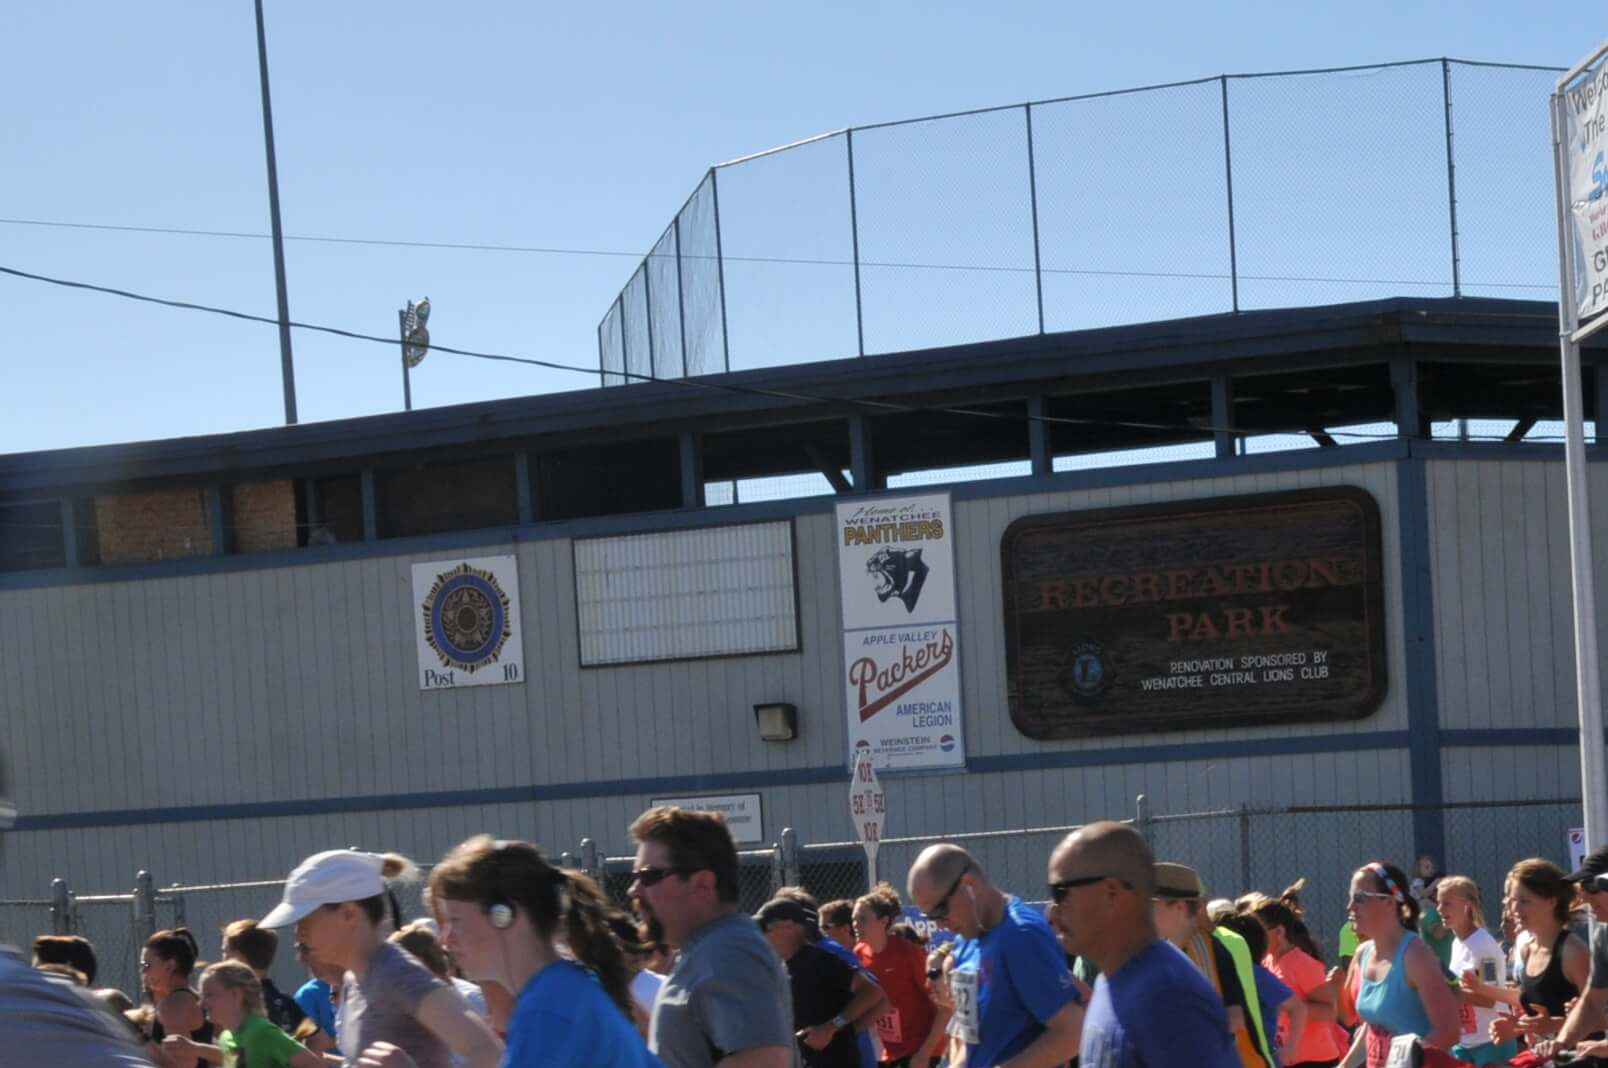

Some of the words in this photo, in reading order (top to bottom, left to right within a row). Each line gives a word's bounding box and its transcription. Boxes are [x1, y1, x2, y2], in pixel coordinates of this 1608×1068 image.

[1584, 112, 1606, 145] The
[845, 511, 941, 525] WENATCHEE
[843, 519, 944, 547] PANTHERS
[1038, 556, 1347, 611] RECREATION
[1167, 603, 1296, 641] PARK
[861, 634, 896, 647] APPLE
[897, 631, 938, 643] VALLEY
[424, 669, 455, 687] Post
[503, 662, 518, 682] 10
[848, 627, 954, 718] Packers
[1170, 658, 1234, 674] RENOVATION
[1240, 652, 1307, 668] SPONSORED
[1312, 651, 1328, 664] BY
[1141, 675, 1203, 691] WENATCHEE
[1210, 671, 1257, 686] CENTRAL
[1263, 668, 1295, 682] LIONS
[1300, 666, 1329, 679] CLUB
[896, 701, 952, 716] AMERICAN
[912, 714, 953, 728] LEGION
